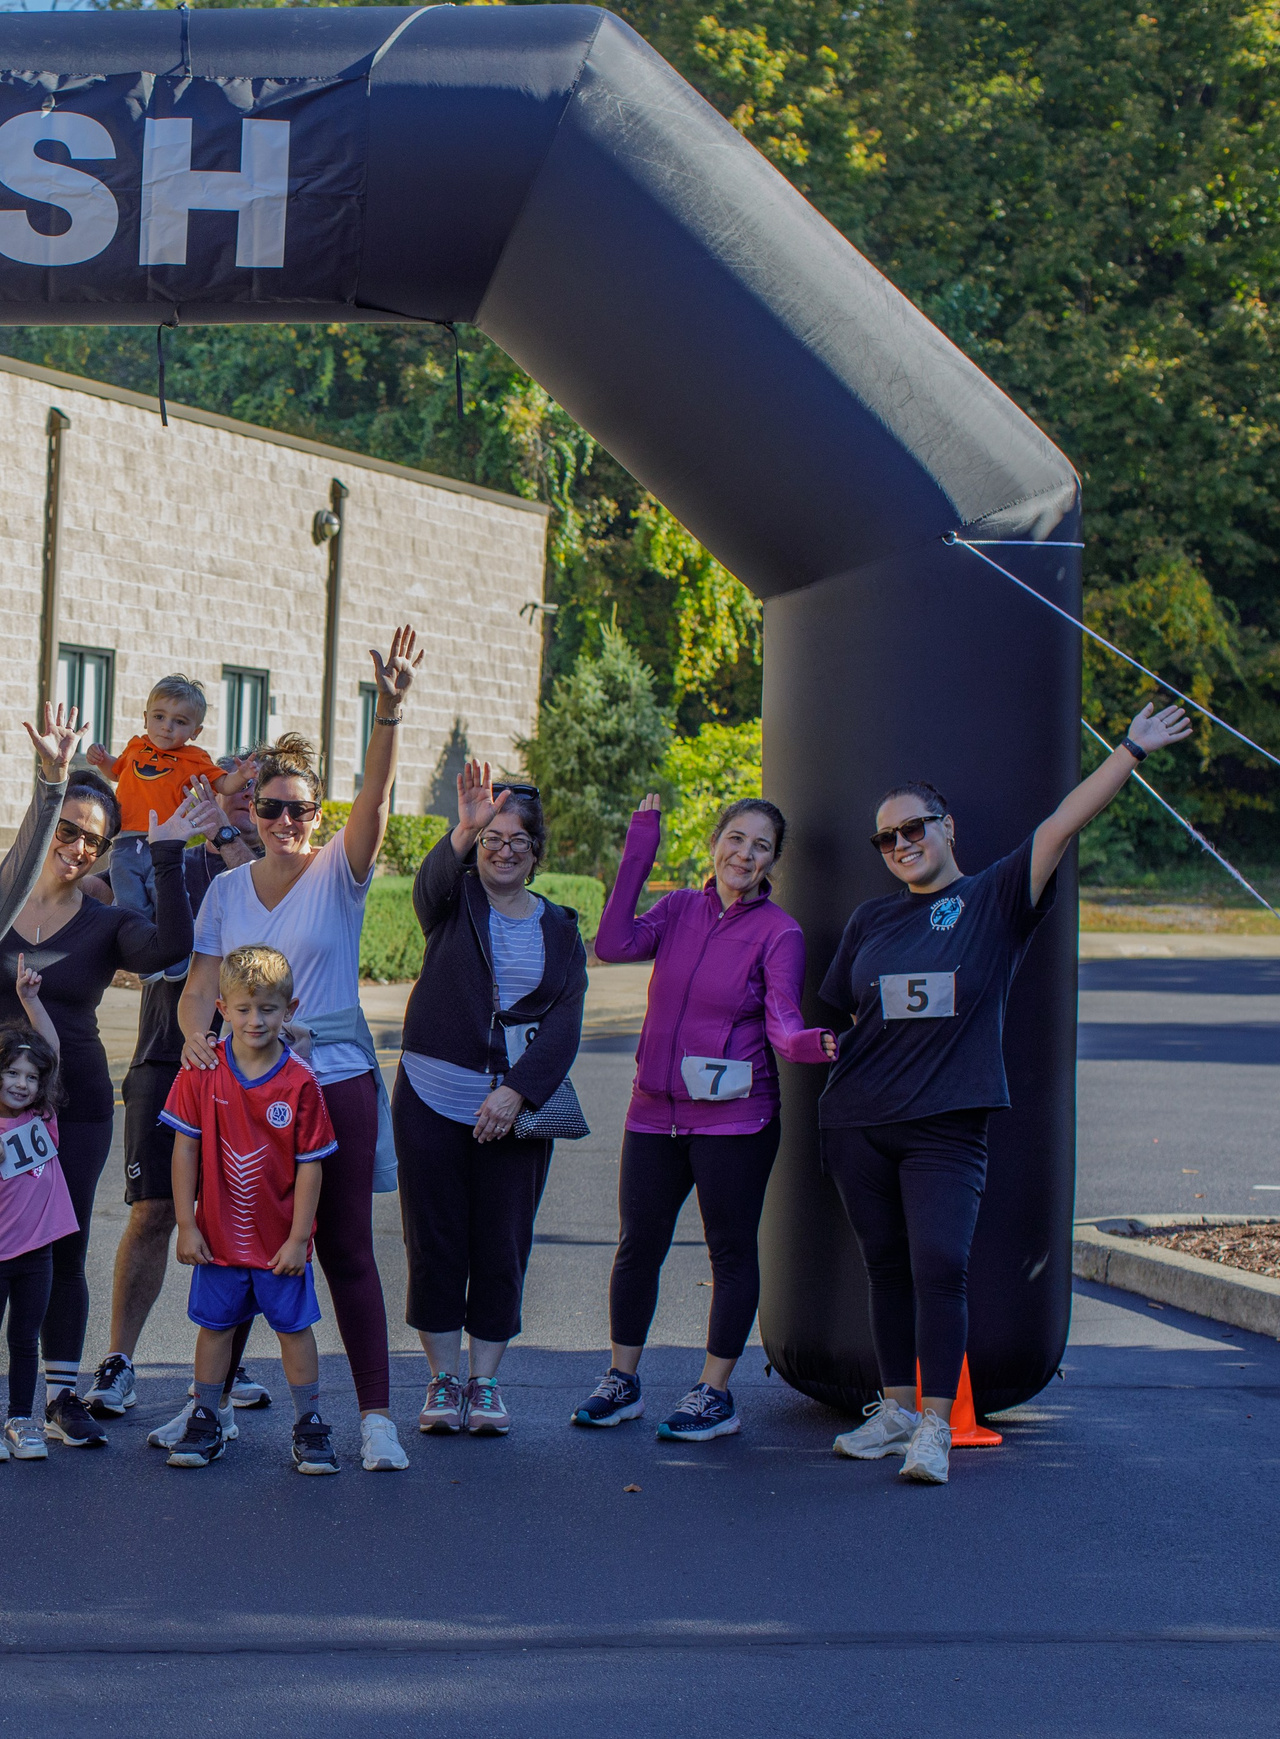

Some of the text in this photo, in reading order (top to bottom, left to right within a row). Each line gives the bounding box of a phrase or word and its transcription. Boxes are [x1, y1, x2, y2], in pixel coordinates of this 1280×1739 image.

[907, 979, 929, 1012] 5
[705, 1063, 727, 1095] 7
[6, 1124, 48, 1169] 16
